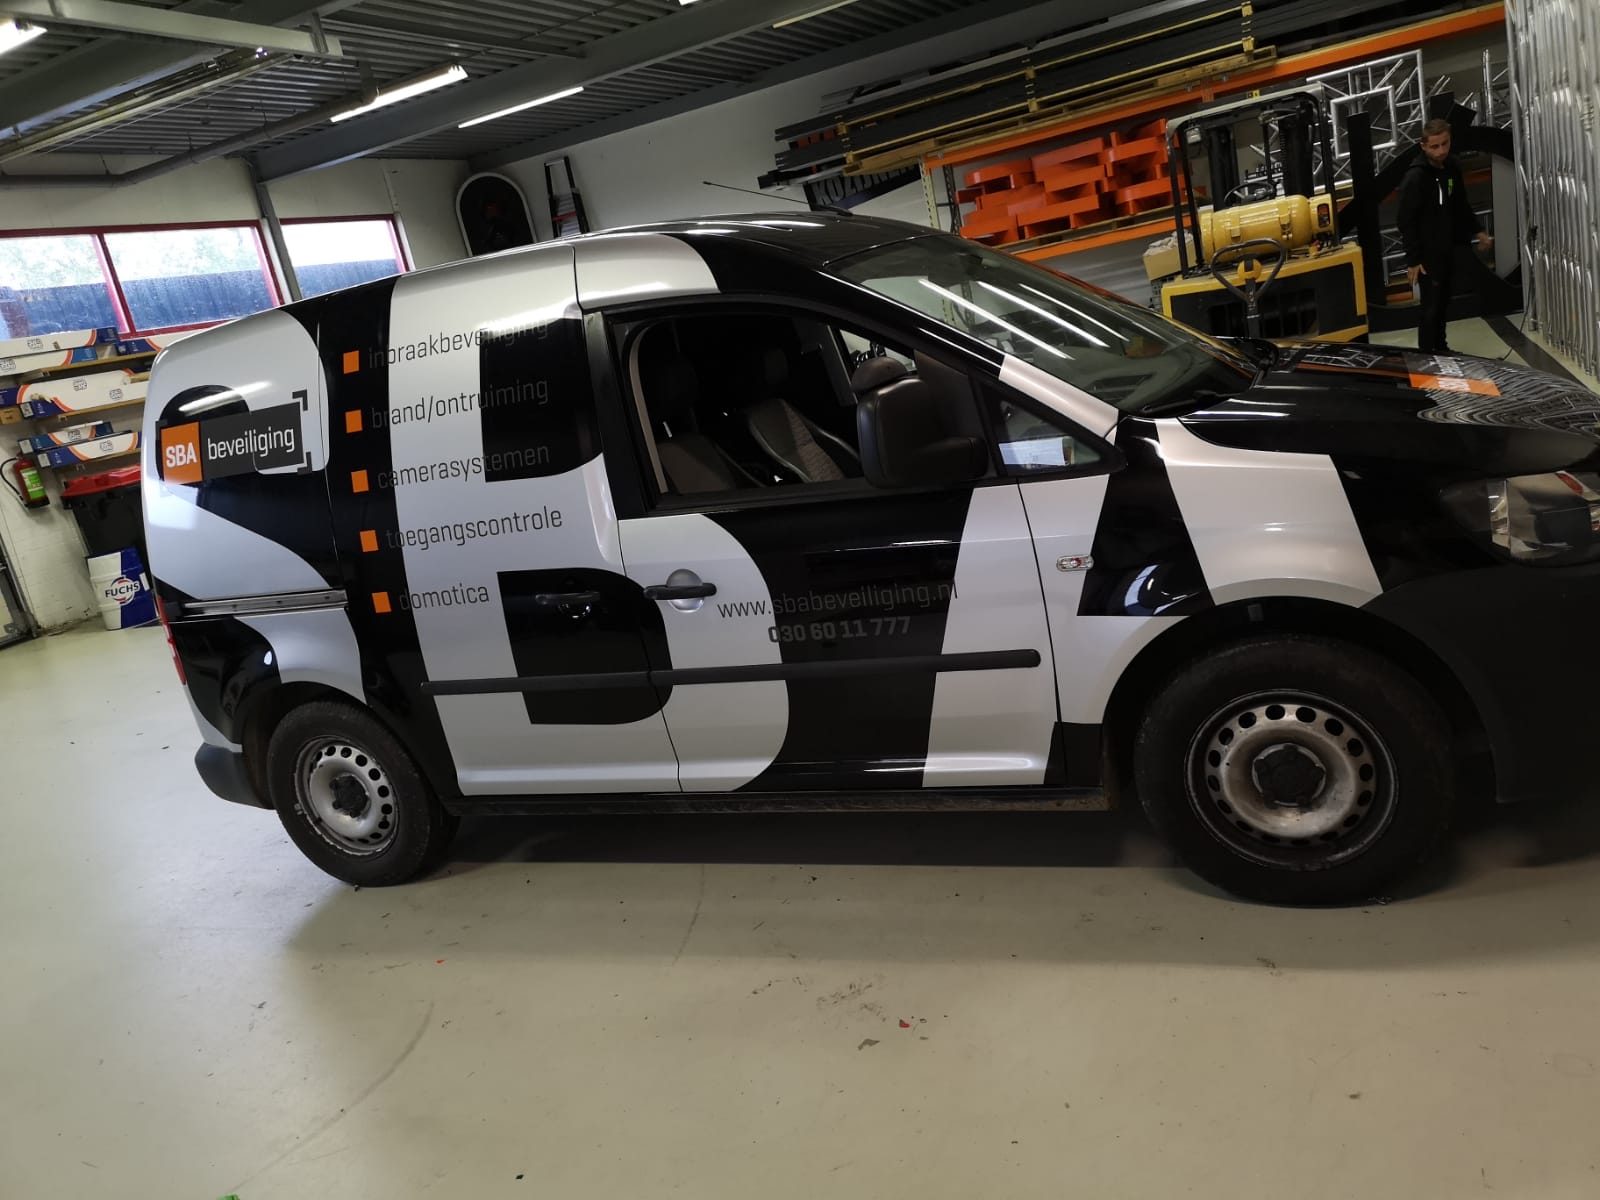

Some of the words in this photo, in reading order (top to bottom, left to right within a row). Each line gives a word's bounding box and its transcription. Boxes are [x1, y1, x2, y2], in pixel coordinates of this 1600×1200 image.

[811, 164, 917, 206] KOZIJ
[371, 379, 550, 429] brand/ontruiming
[165, 442, 197, 468] SBA
[207, 426, 296, 460] beveiliging
[377, 445, 551, 489] camerasystemen
[385, 505, 563, 551] toegangscontrole
[105, 580, 140, 598] FUCHS
[399, 582, 490, 611] domotica
[717, 580, 958, 618] www.sbabeveiliging.nl
[768, 624, 807, 643] 030
[810, 621, 837, 641] 60
[839, 618, 868, 639] 11
[870, 615, 912, 636] 777
